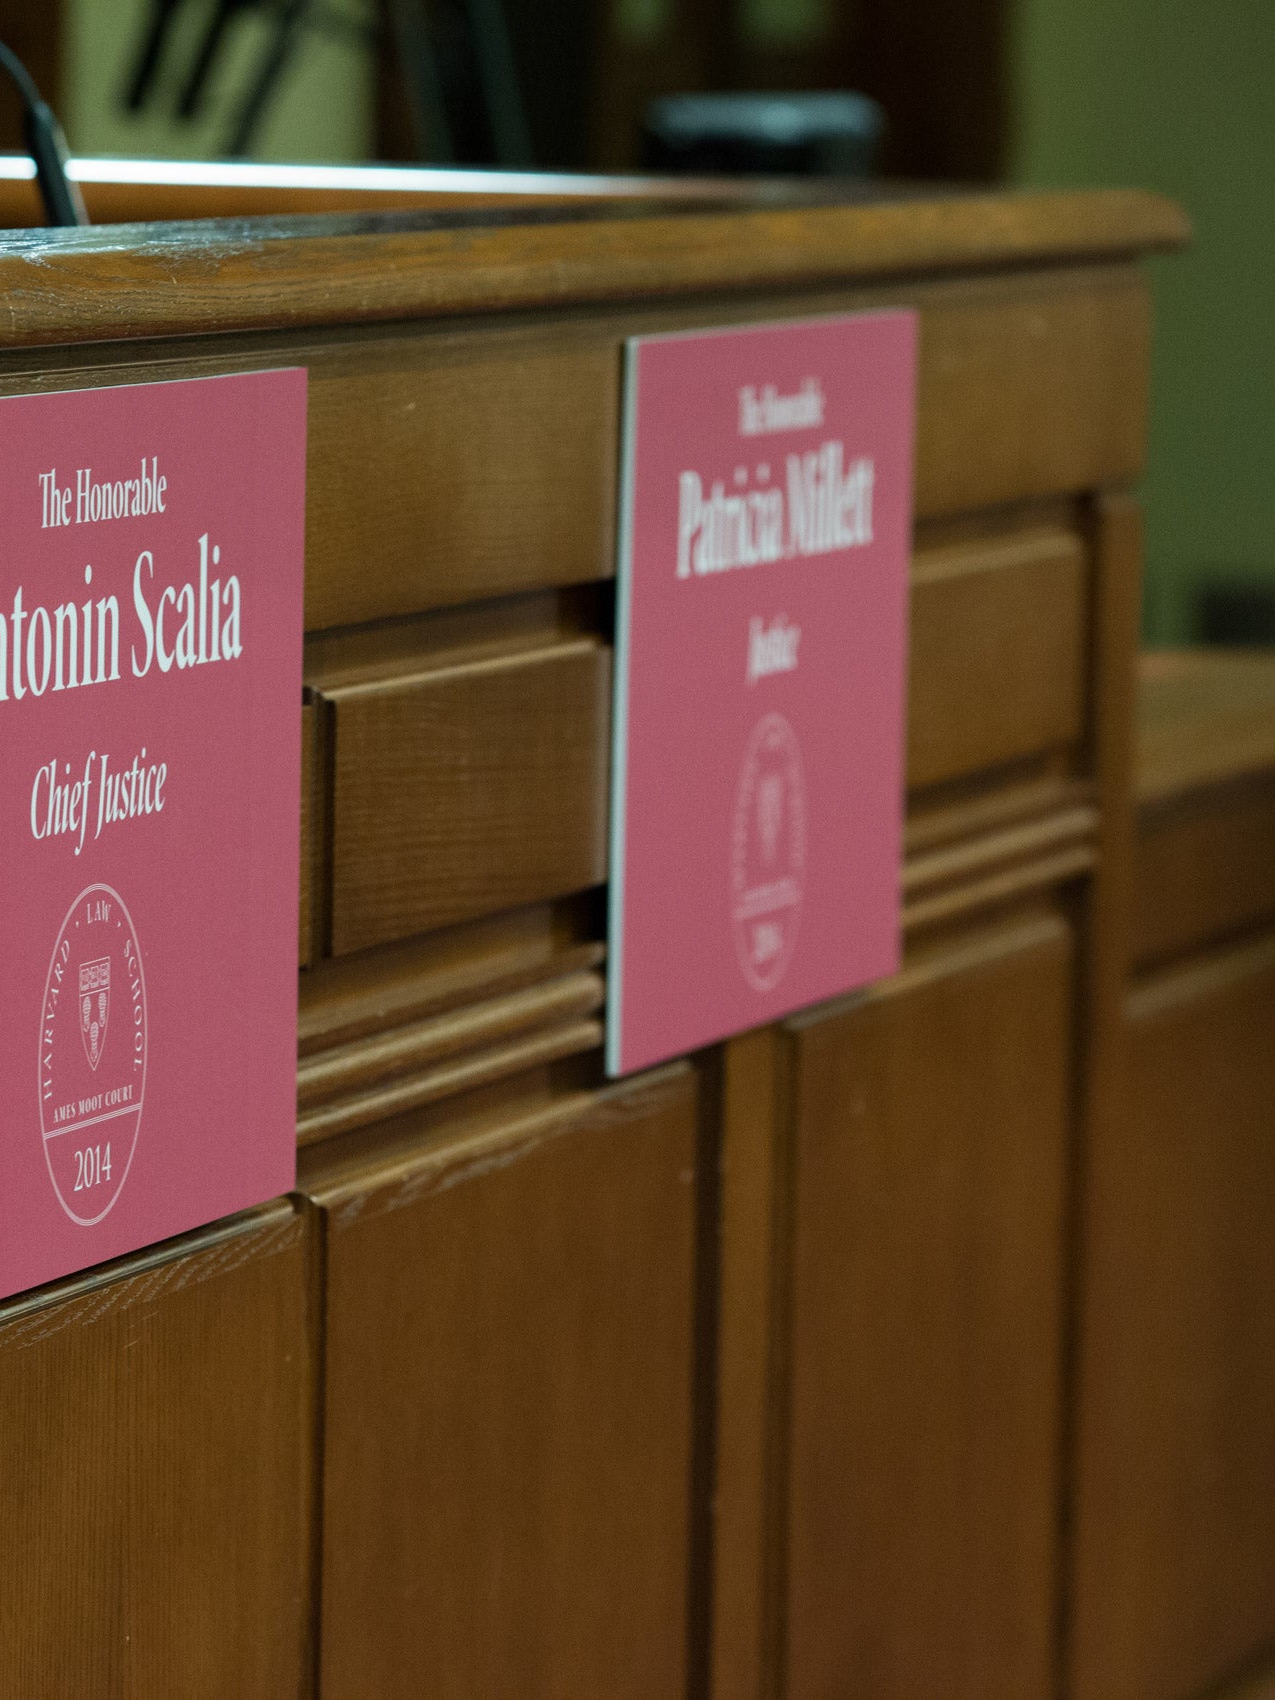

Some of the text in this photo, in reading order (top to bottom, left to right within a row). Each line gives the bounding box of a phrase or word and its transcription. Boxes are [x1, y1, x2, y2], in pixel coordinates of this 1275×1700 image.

[39, 455, 168, 528] The Honorable
[131, 532, 243, 678] Scalia
[31, 747, 168, 856] Chief Justice
[86, 899, 112, 925] LAW
[53, 1084, 133, 1123] AMES MOOT COURT
[73, 1142, 112, 1192] 2014
